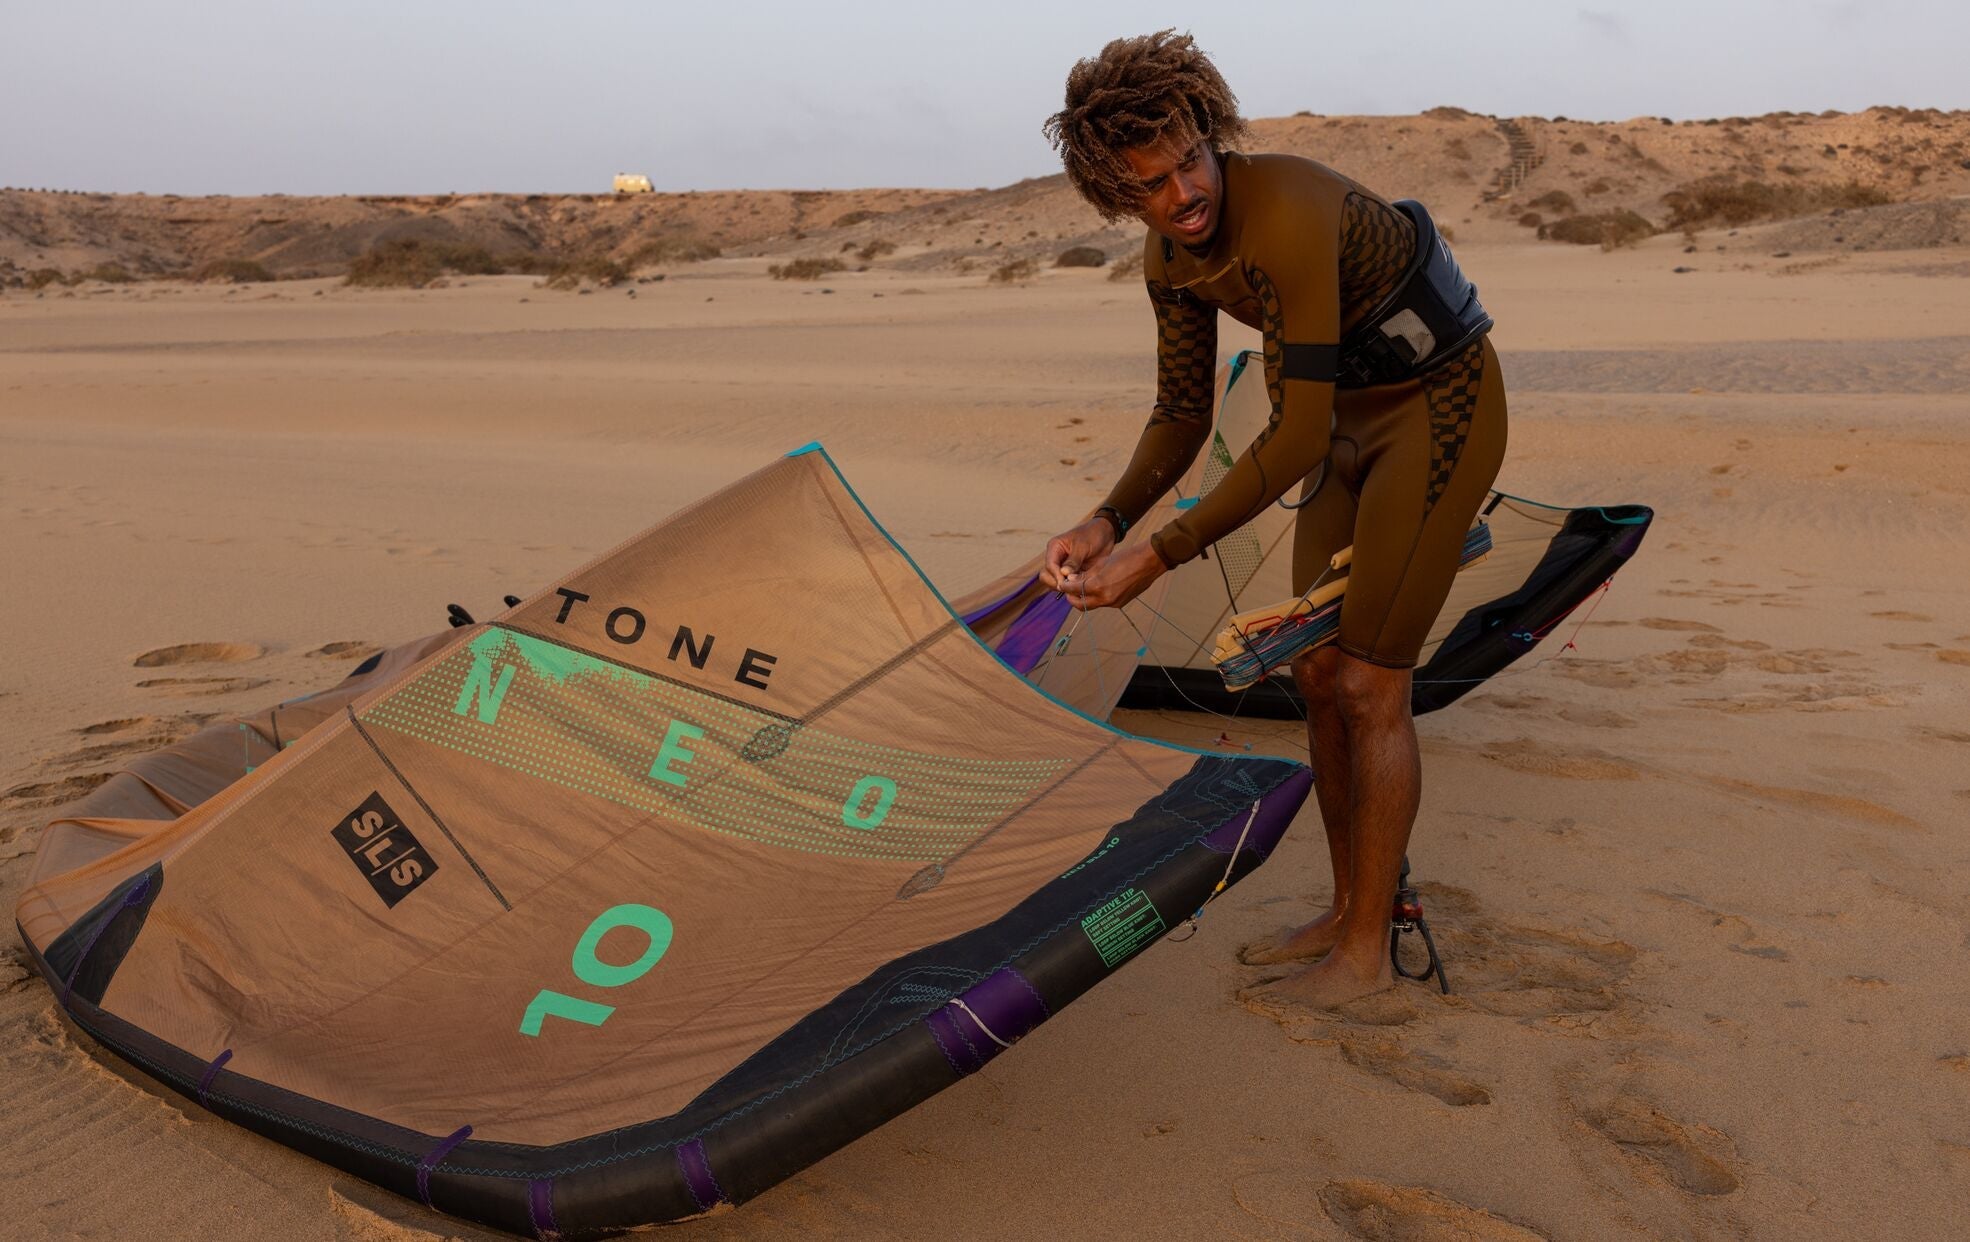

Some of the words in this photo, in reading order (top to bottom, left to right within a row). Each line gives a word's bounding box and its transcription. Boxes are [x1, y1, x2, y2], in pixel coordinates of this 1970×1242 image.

[556, 587, 778, 690] TONE
[453, 656, 897, 831] NEO
[1106, 837, 1120, 849] 10
[1081, 897, 1121, 928] ADAPTIVE
[1120, 888, 1135, 900] TIP
[518, 903, 674, 1037] 10
